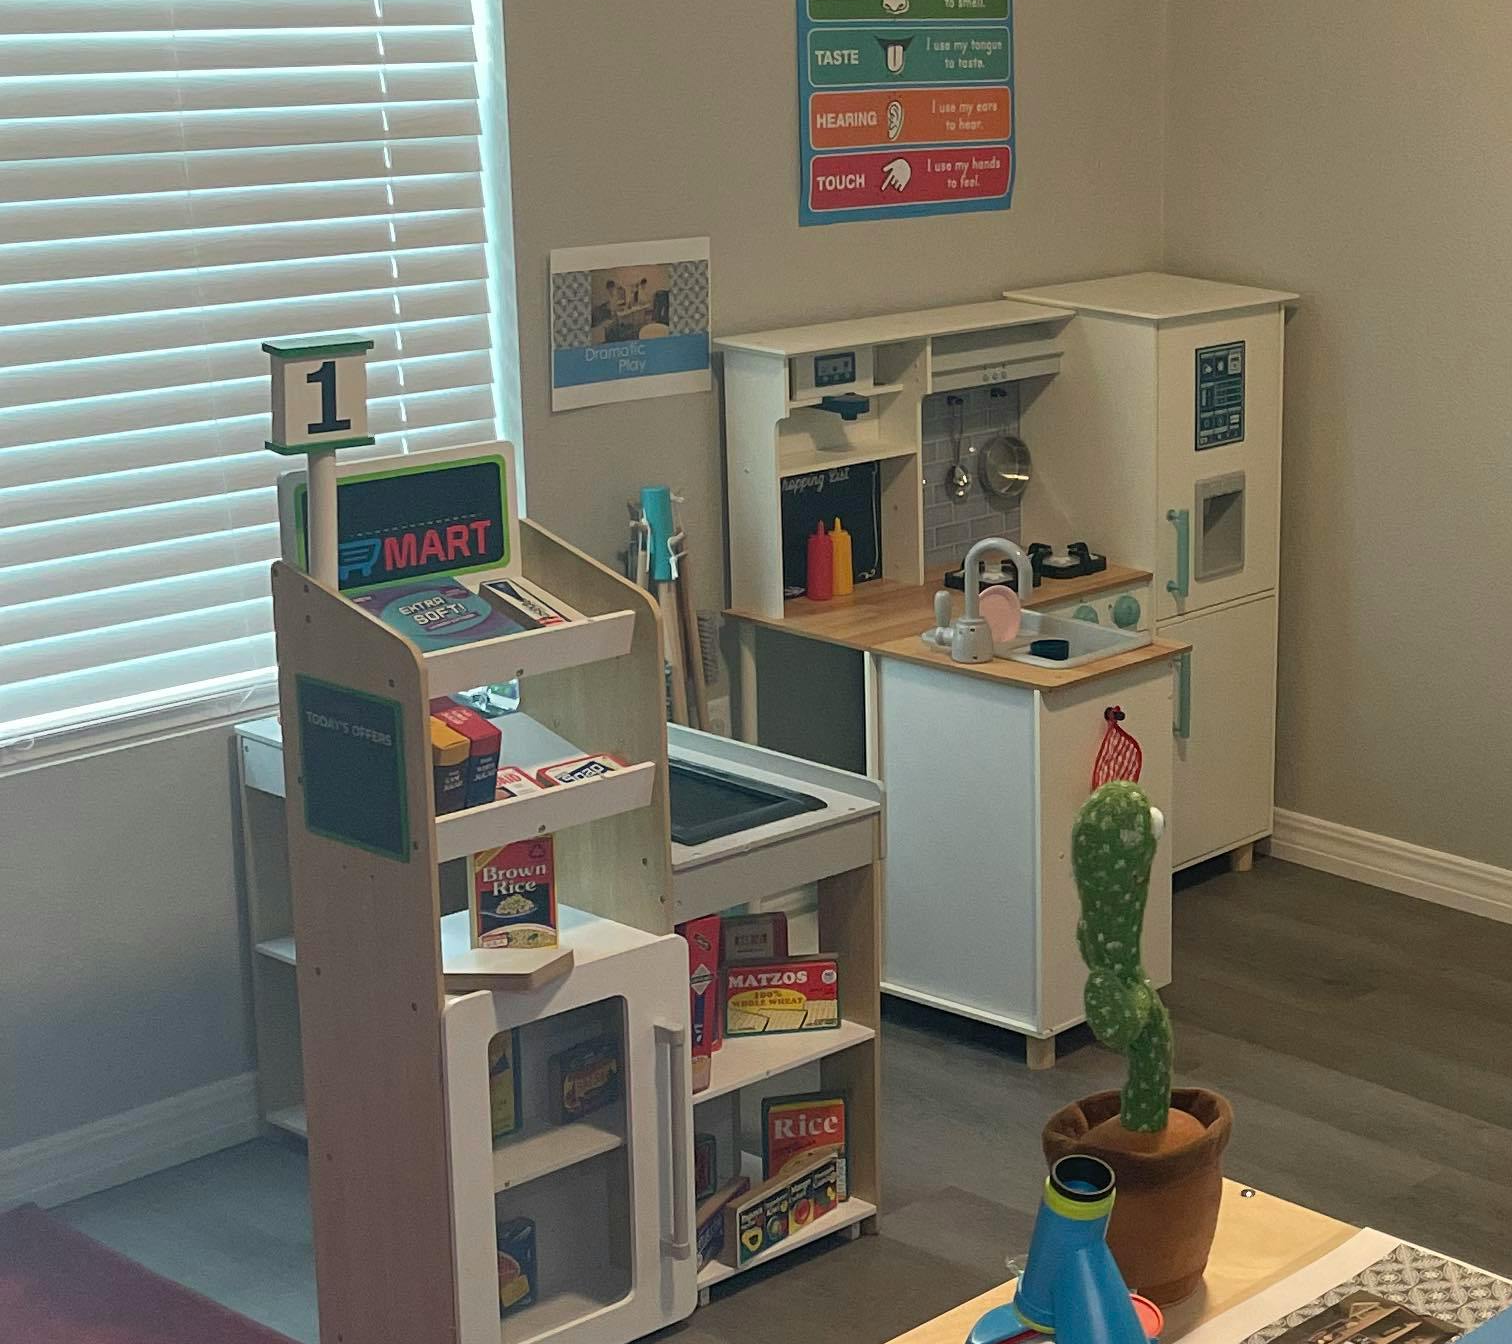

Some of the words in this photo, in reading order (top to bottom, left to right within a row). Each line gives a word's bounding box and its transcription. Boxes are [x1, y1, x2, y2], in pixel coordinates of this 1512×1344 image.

[933, 40, 950, 51] use
[954, 41, 968, 54] my
[971, 40, 1002, 54] tongue
[814, 50, 859, 65] TASTE
[944, 58, 955, 68] to
[957, 57, 985, 69] taste.
[939, 103, 955, 114] use
[959, 102, 973, 115] my
[976, 101, 997, 112] ears
[816, 112, 877, 128] HEARING
[945, 119, 956, 131] to
[958, 117, 984, 131] hear.
[934, 162, 952, 173] use
[955, 161, 969, 174] my
[972, 157, 1000, 170] hands
[816, 174, 865, 191] TOUCH
[947, 177, 958, 189] to
[960, 174, 980, 188] feel.
[584, 343, 646, 361] Dramatic
[618, 359, 647, 373] Play
[306, 361, 351, 435] 1
[383, 519, 492, 571] MART
[399, 596, 445, 615] EXTRA
[413, 603, 467, 624] SOFT!
[306, 712, 349, 734] TODAY'S
[352, 725, 392, 746] OFFERS
[483, 863, 546, 883] Brown
[493, 880, 537, 896] Rice
[729, 971, 807, 988] MATZOS
[769, 997, 803, 1005] WHEAT
[773, 1114, 838, 1139] Rice
